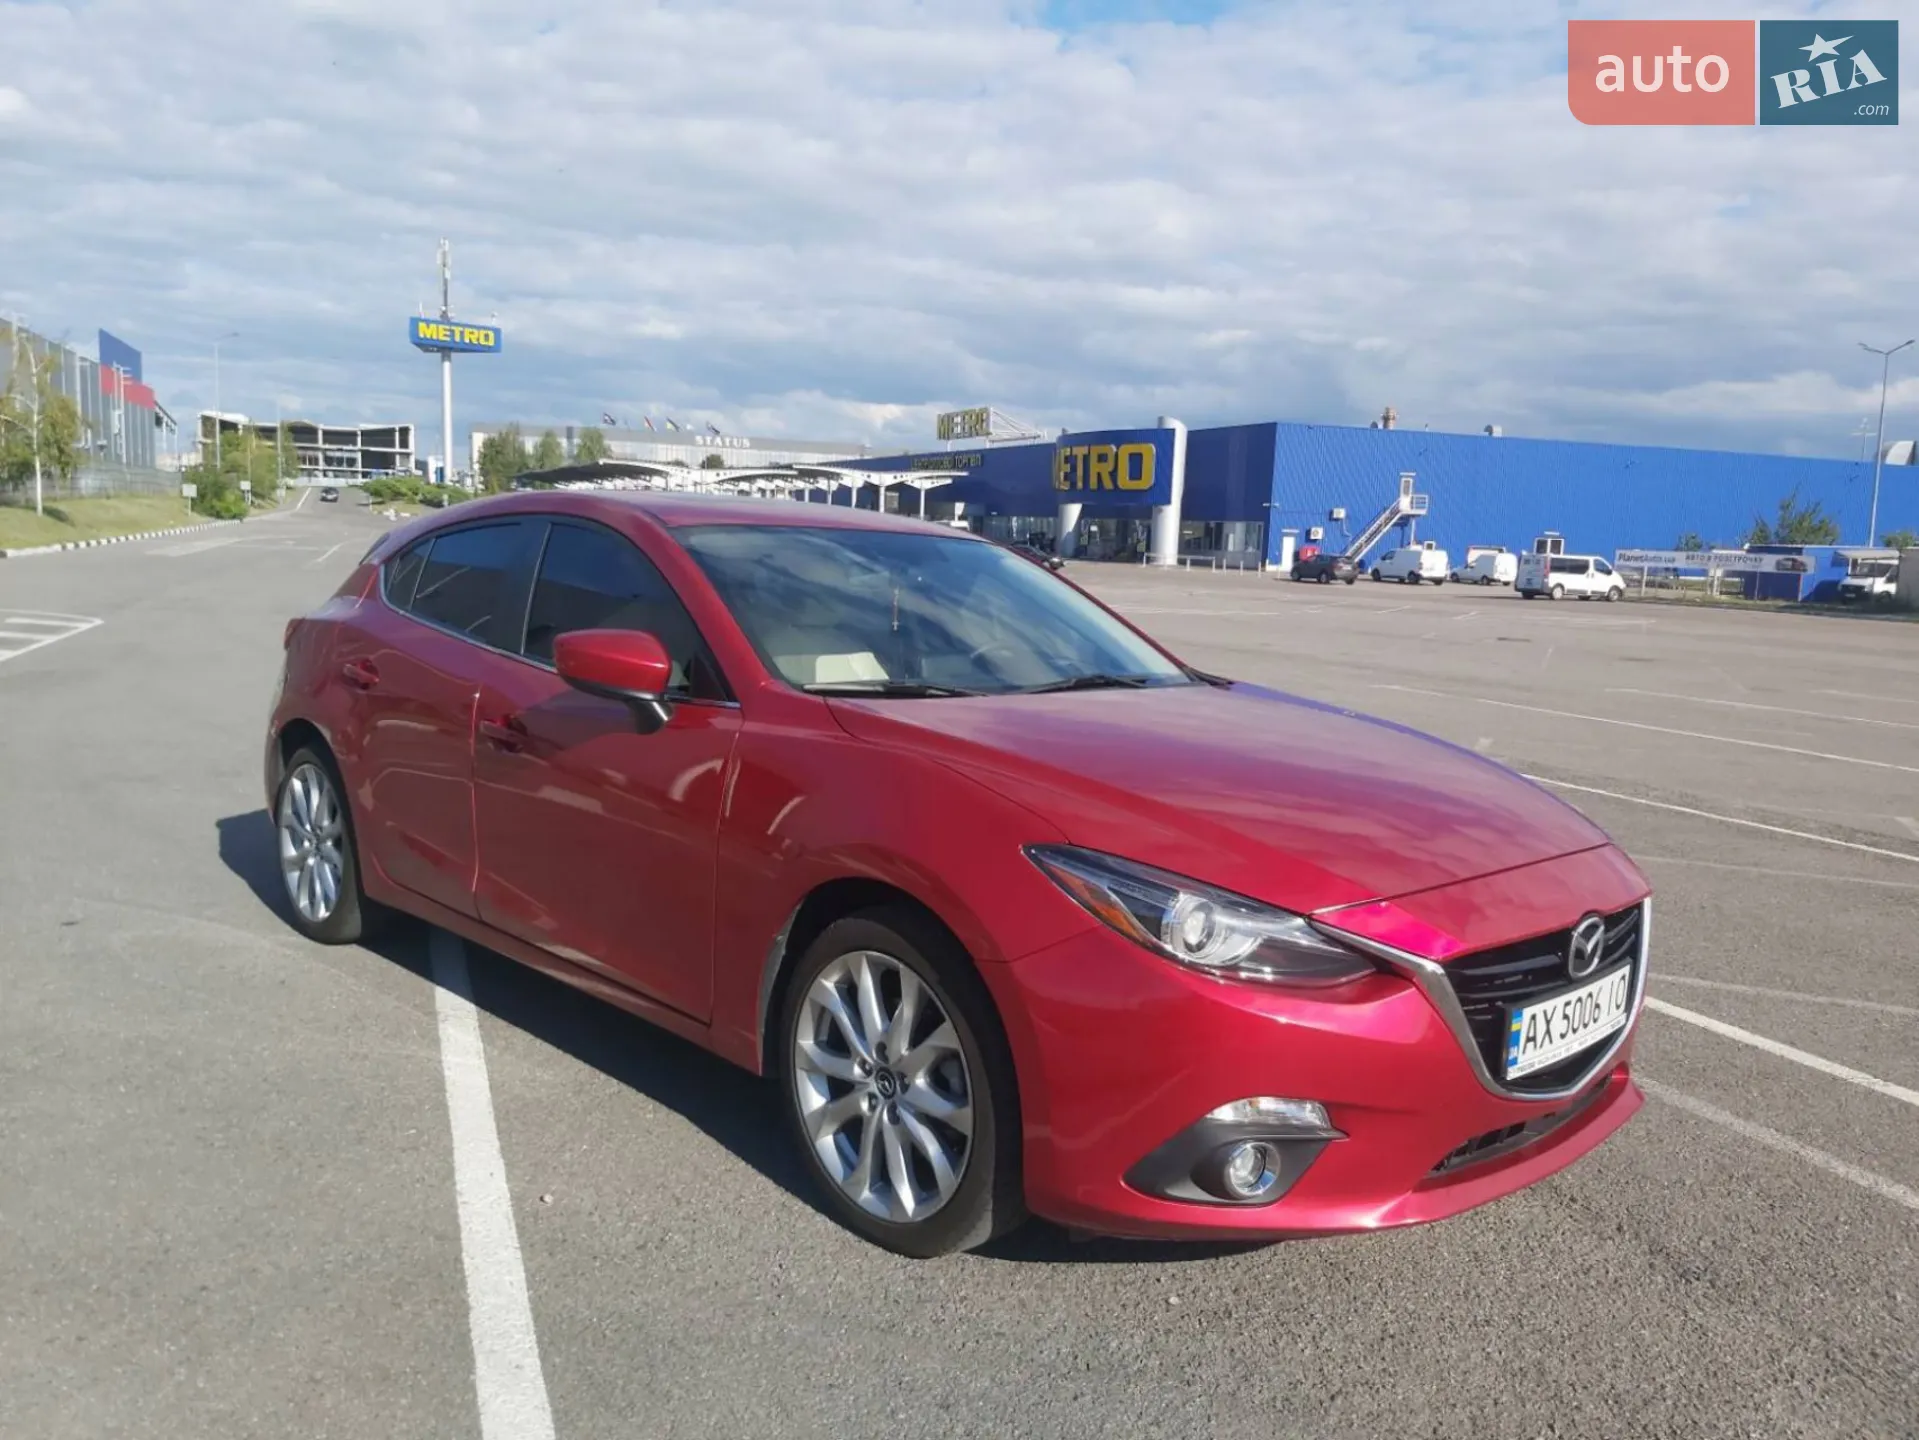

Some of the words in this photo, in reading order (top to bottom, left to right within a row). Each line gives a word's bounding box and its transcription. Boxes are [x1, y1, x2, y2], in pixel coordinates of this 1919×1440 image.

[417, 321, 496, 347] METRO
[695, 435, 751, 449] STATUS
[1522, 1005, 1557, 1055] AX
[1559, 985, 1603, 1040] 5006
